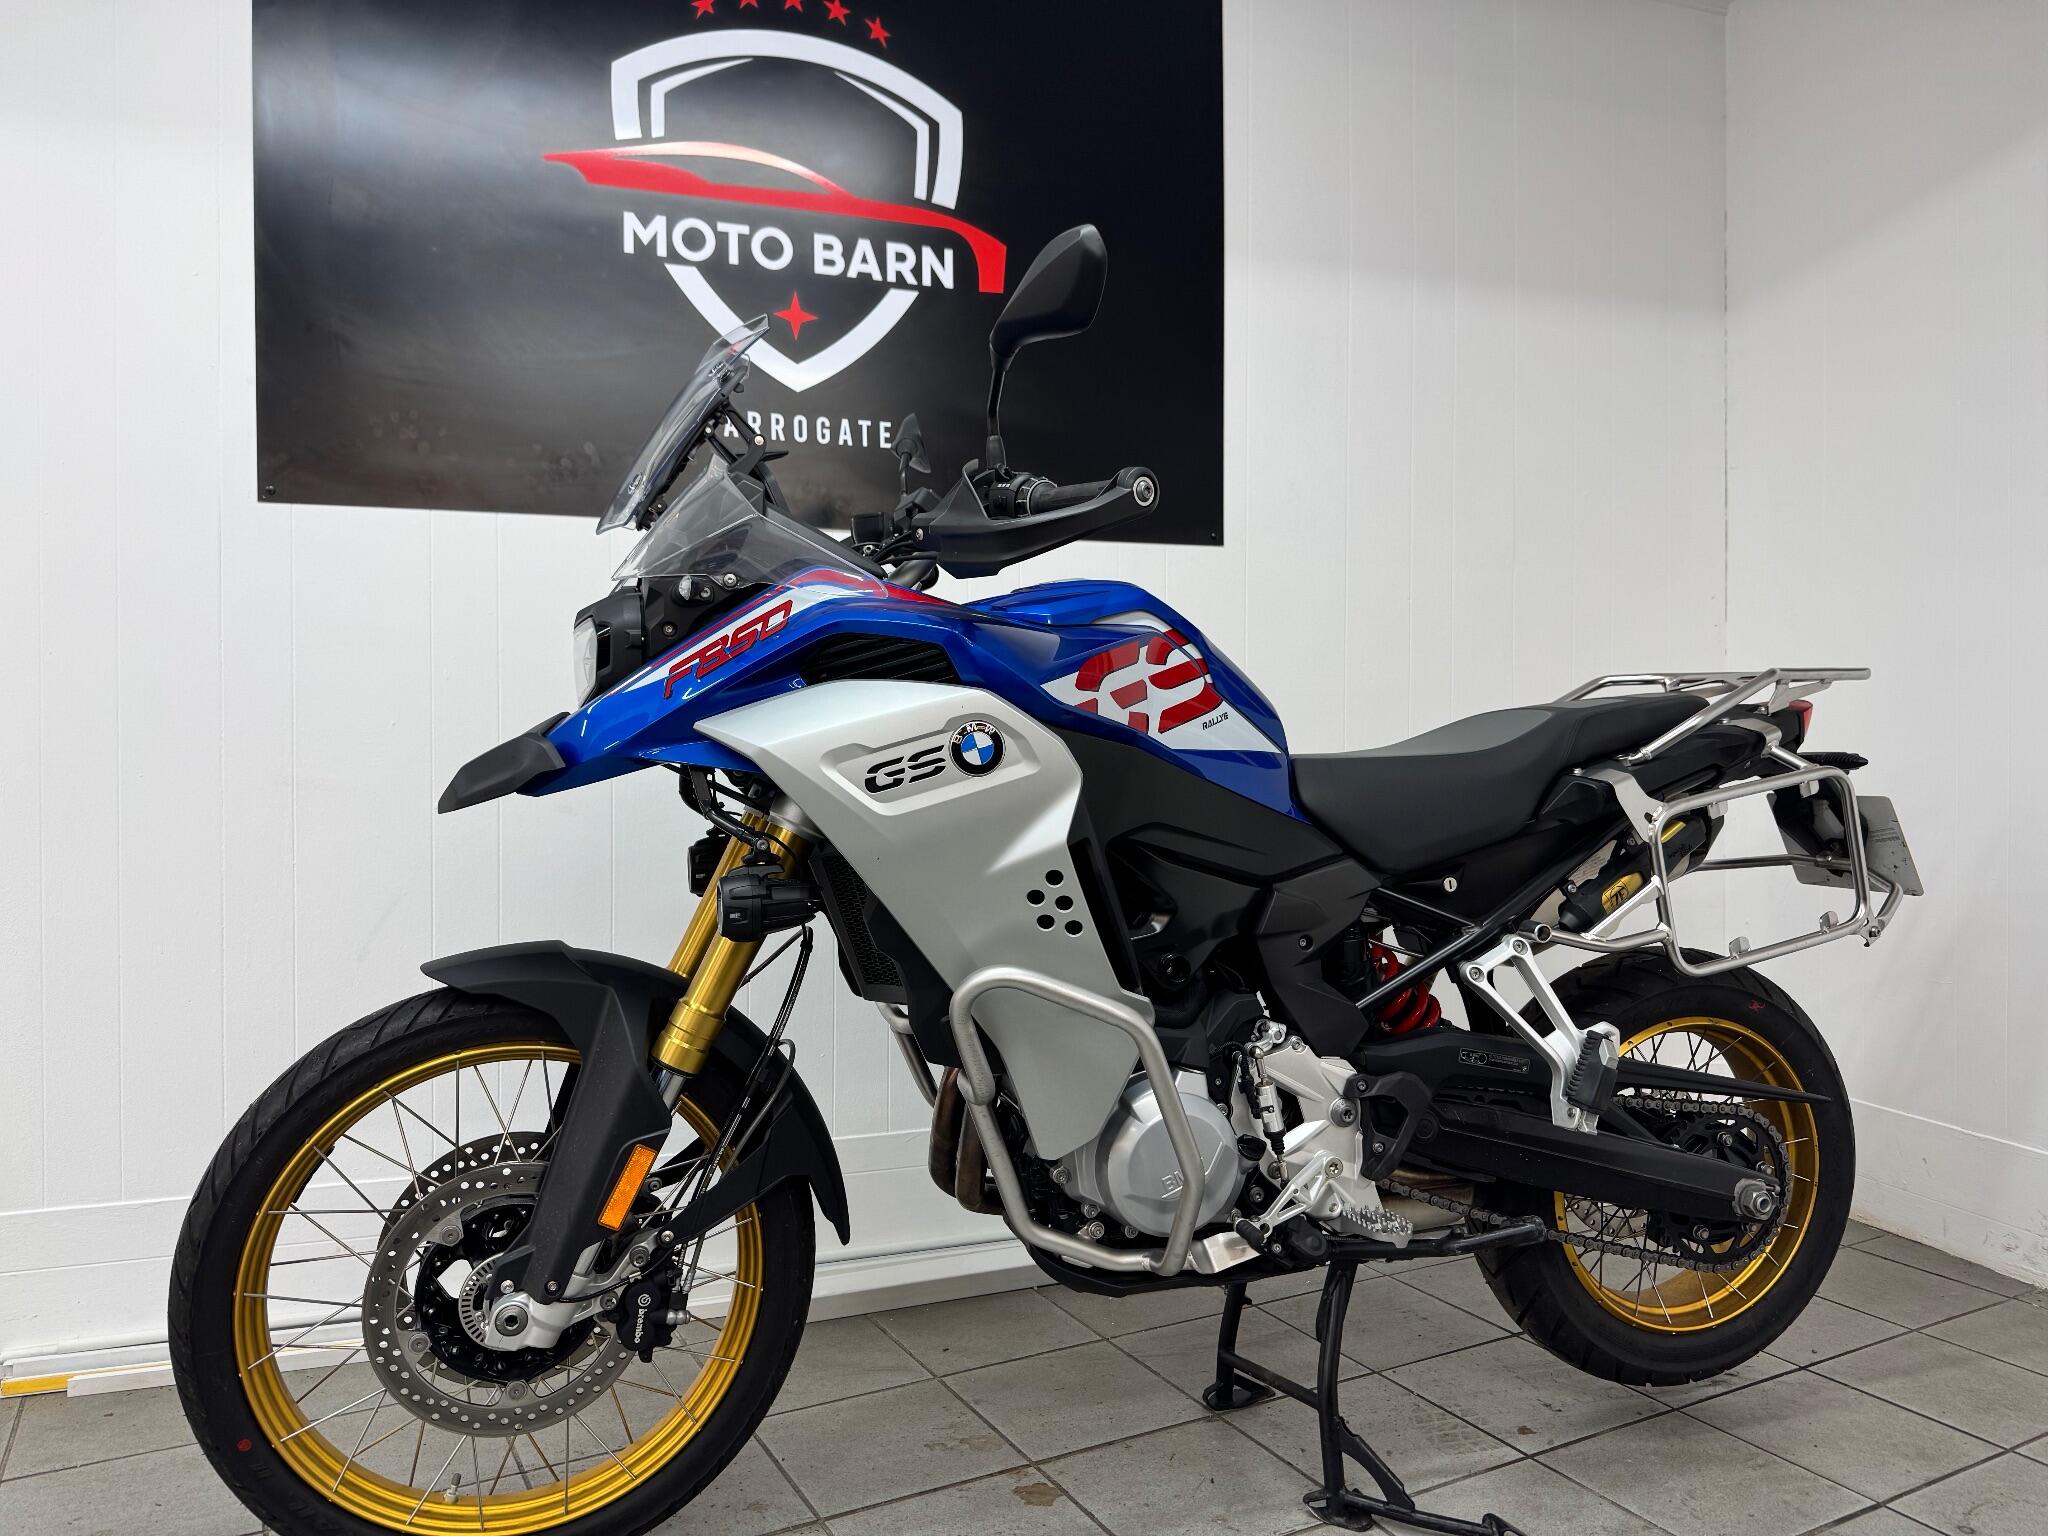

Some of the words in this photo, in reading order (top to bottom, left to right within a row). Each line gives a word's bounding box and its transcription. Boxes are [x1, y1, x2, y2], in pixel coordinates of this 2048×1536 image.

[623, 211, 794, 271] MOTO
[813, 232, 954, 289] BARN
[723, 411, 892, 449] ARROGATE
[664, 600, 793, 699] F850
[950, 721, 997, 744] BMW
[1201, 711, 1229, 731] RALLYE
[864, 744, 947, 794] GS
[634, 1308, 648, 1344] brembo
